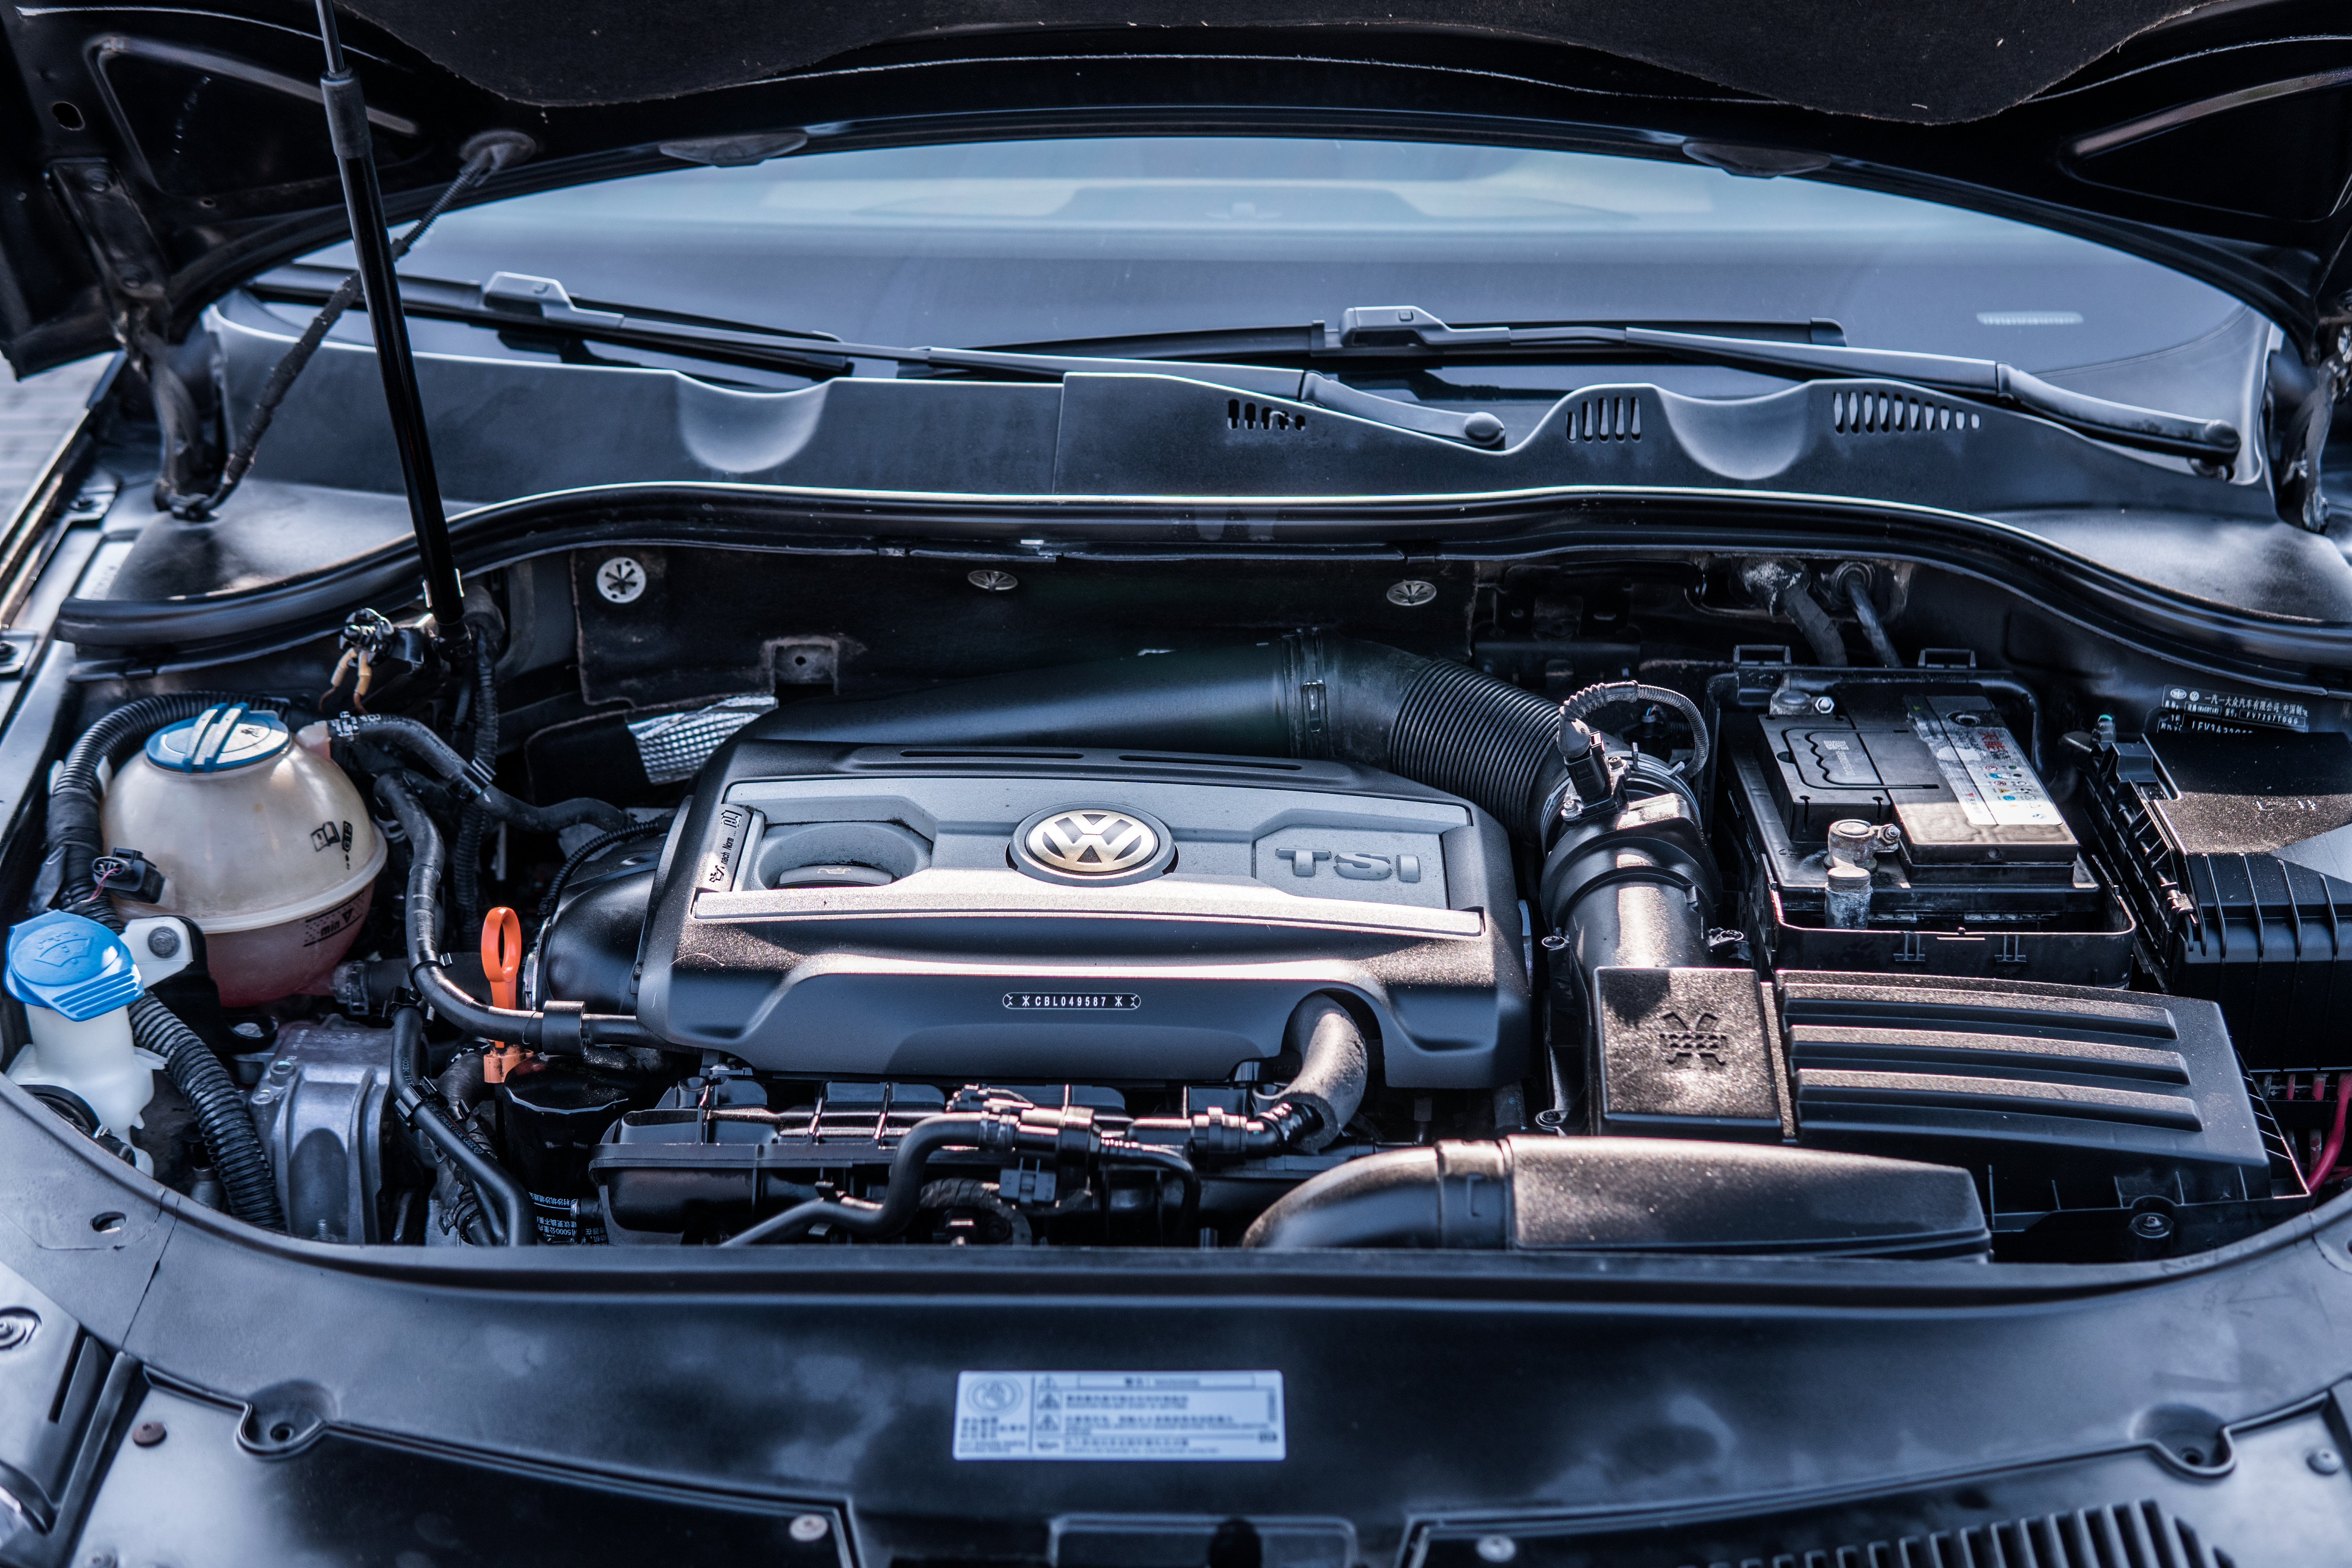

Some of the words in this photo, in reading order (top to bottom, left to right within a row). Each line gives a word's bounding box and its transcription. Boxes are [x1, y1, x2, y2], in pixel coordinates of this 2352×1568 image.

[722, 837, 734, 851] Norm
[720, 851, 730, 865] nach
[1275, 848, 1421, 882] TSI
[321, 920, 340, 936] min
